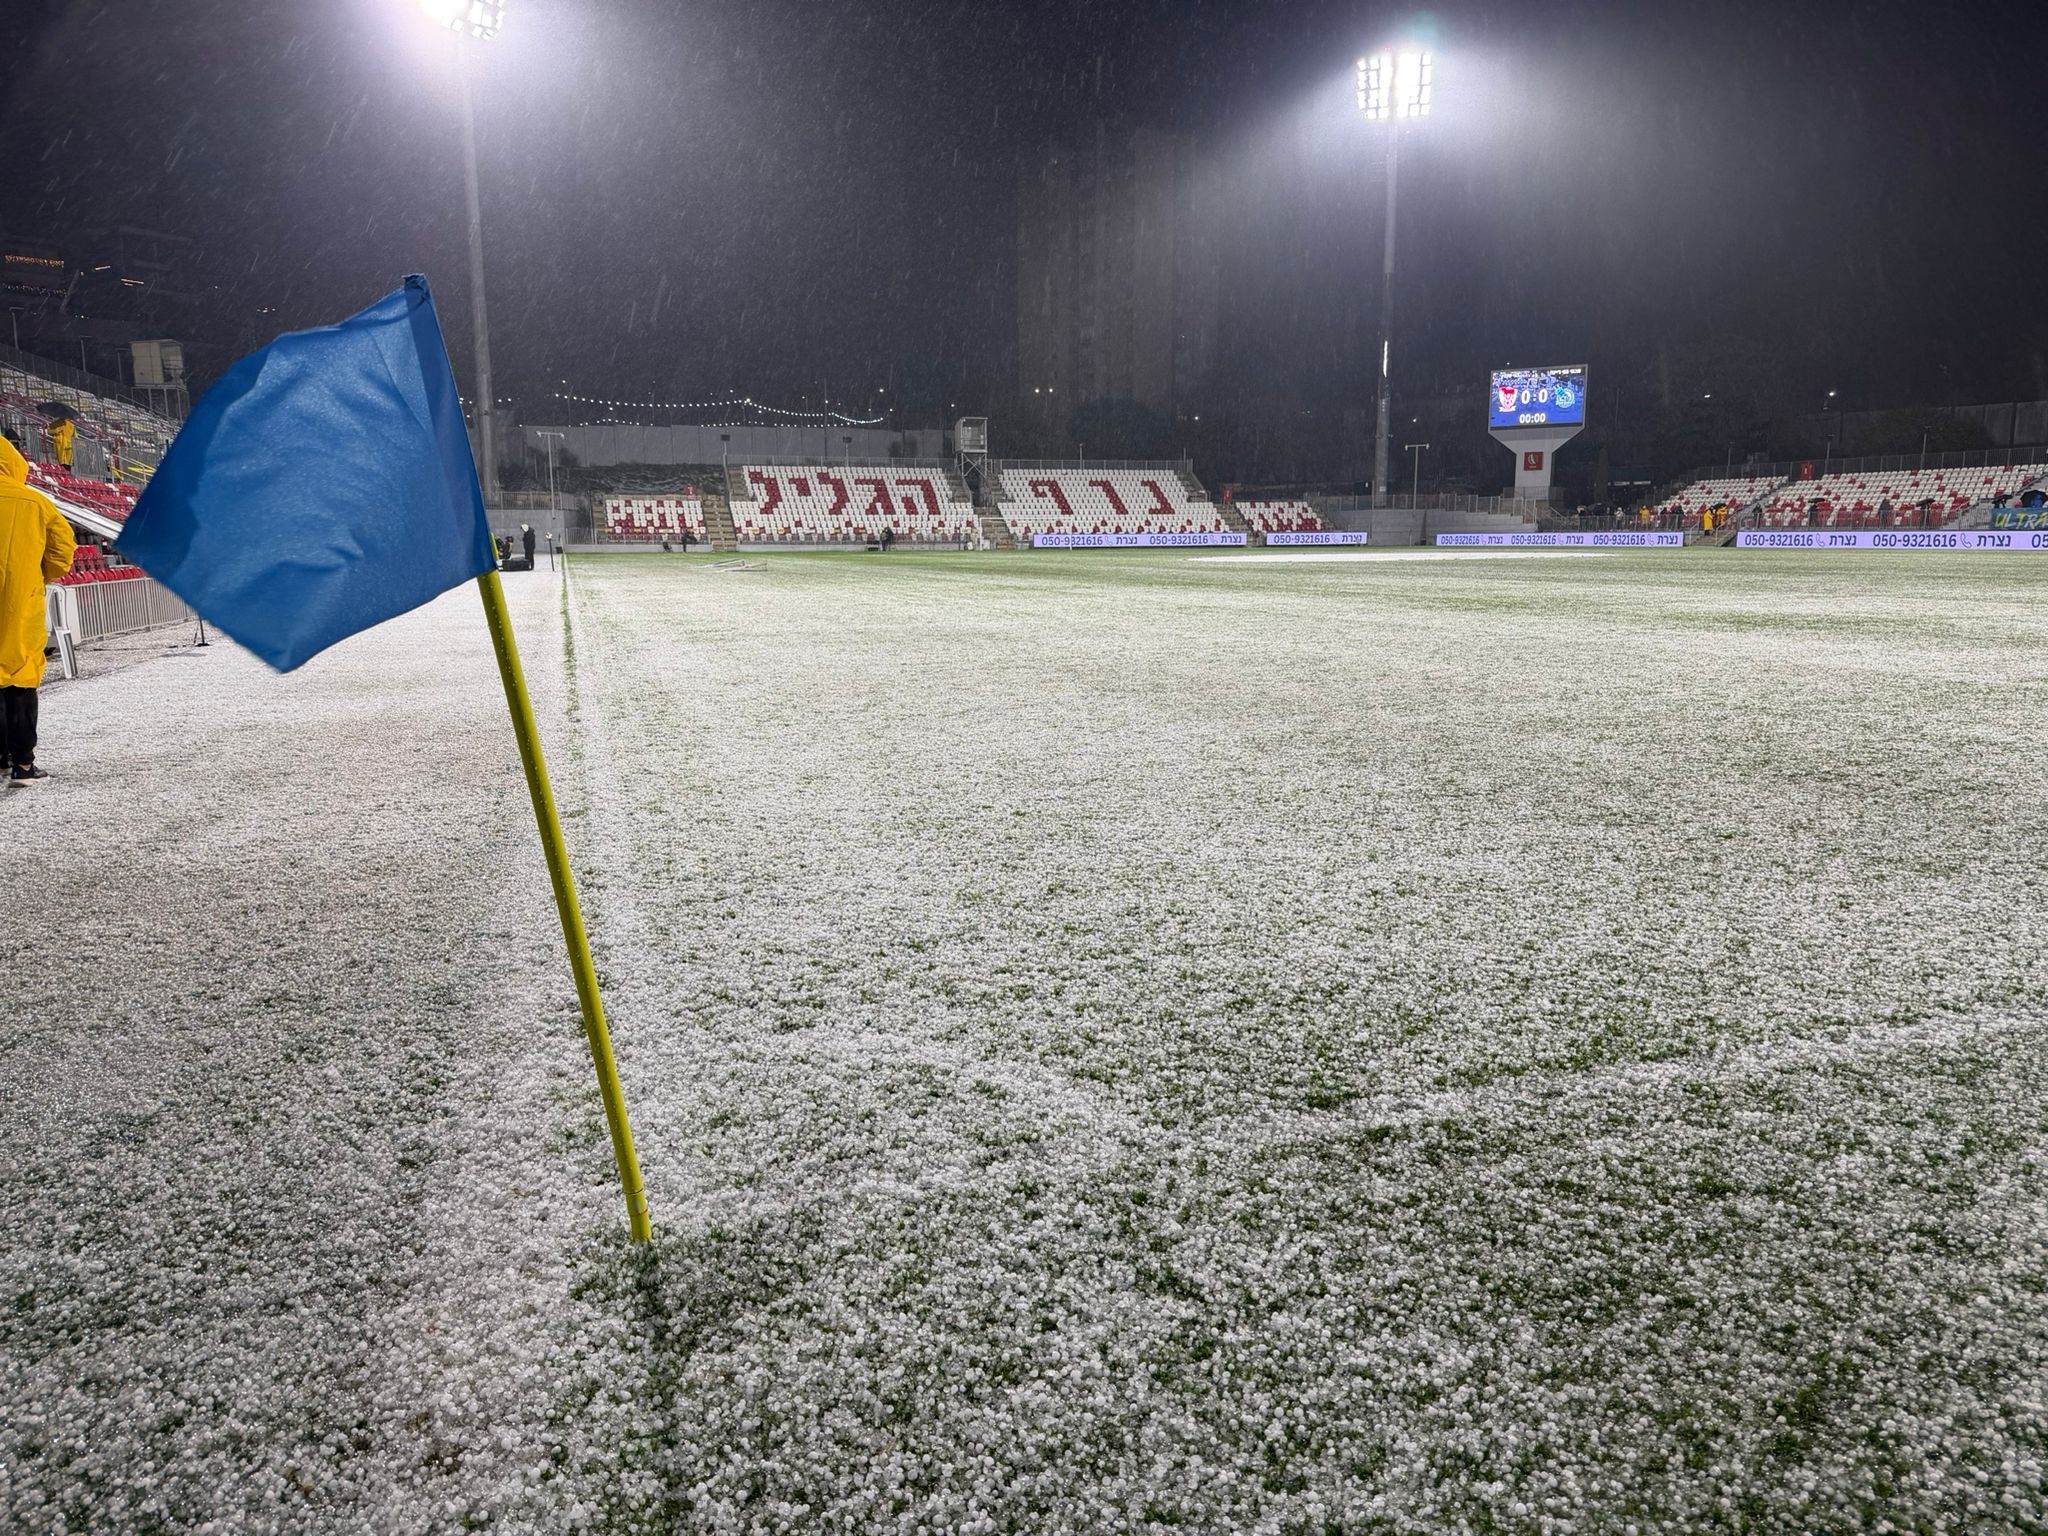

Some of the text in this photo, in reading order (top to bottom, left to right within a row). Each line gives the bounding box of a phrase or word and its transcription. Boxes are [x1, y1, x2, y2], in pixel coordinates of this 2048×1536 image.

[1519, 413, 1546, 424] 00:00
[748, 471, 941, 515] הגליל
[1995, 511, 2048, 529] ULTRA
[1041, 535, 1242, 546] נצרת 050-9321616 נצרת 050-9321616
[1274, 534, 1362, 544] נצרת 050-9321616
[1440, 534, 1678, 545] נצרת 050-9321616 נצרת 050-9321616 נצרת 050-9321616
[1744, 534, 2012, 548] נצרת 050-9321616 נצרת 050-9321616
